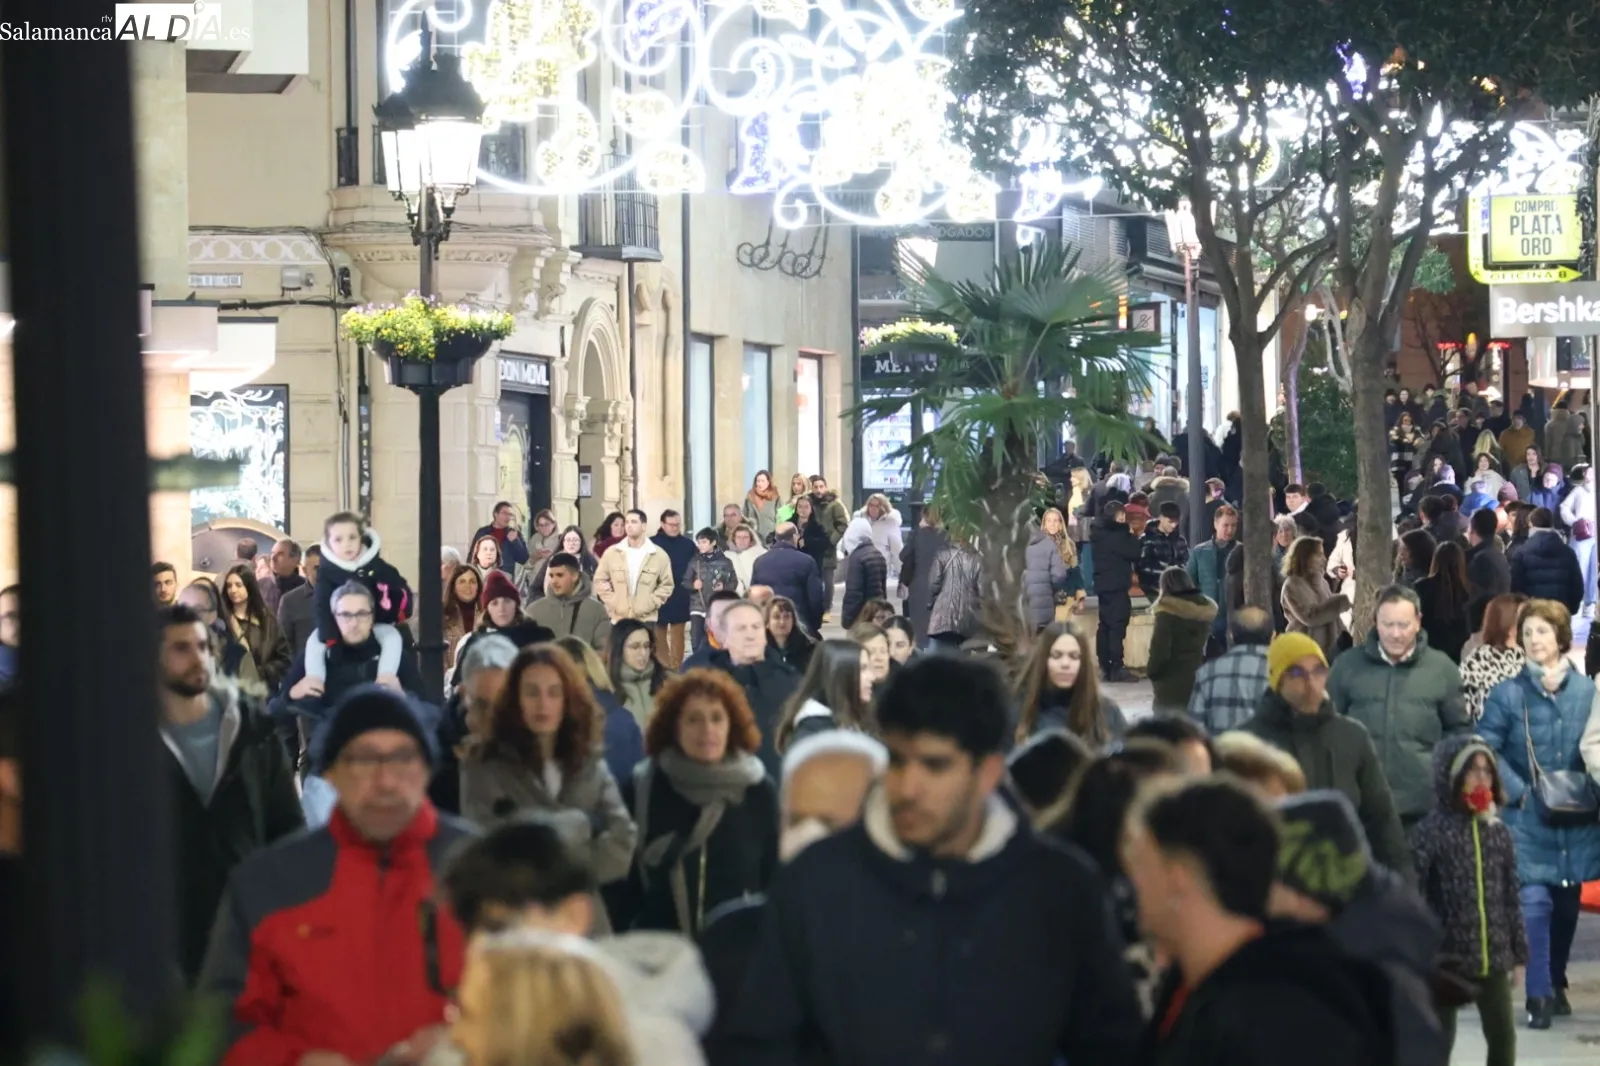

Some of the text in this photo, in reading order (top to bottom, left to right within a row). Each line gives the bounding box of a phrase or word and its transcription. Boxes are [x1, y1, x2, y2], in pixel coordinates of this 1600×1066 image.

[1514, 199, 1557, 213] COMPRO
[928, 226, 993, 239] OGADOS
[1509, 214, 1563, 236] PLATA
[1521, 237, 1552, 256] ORO
[500, 359, 520, 381] DON
